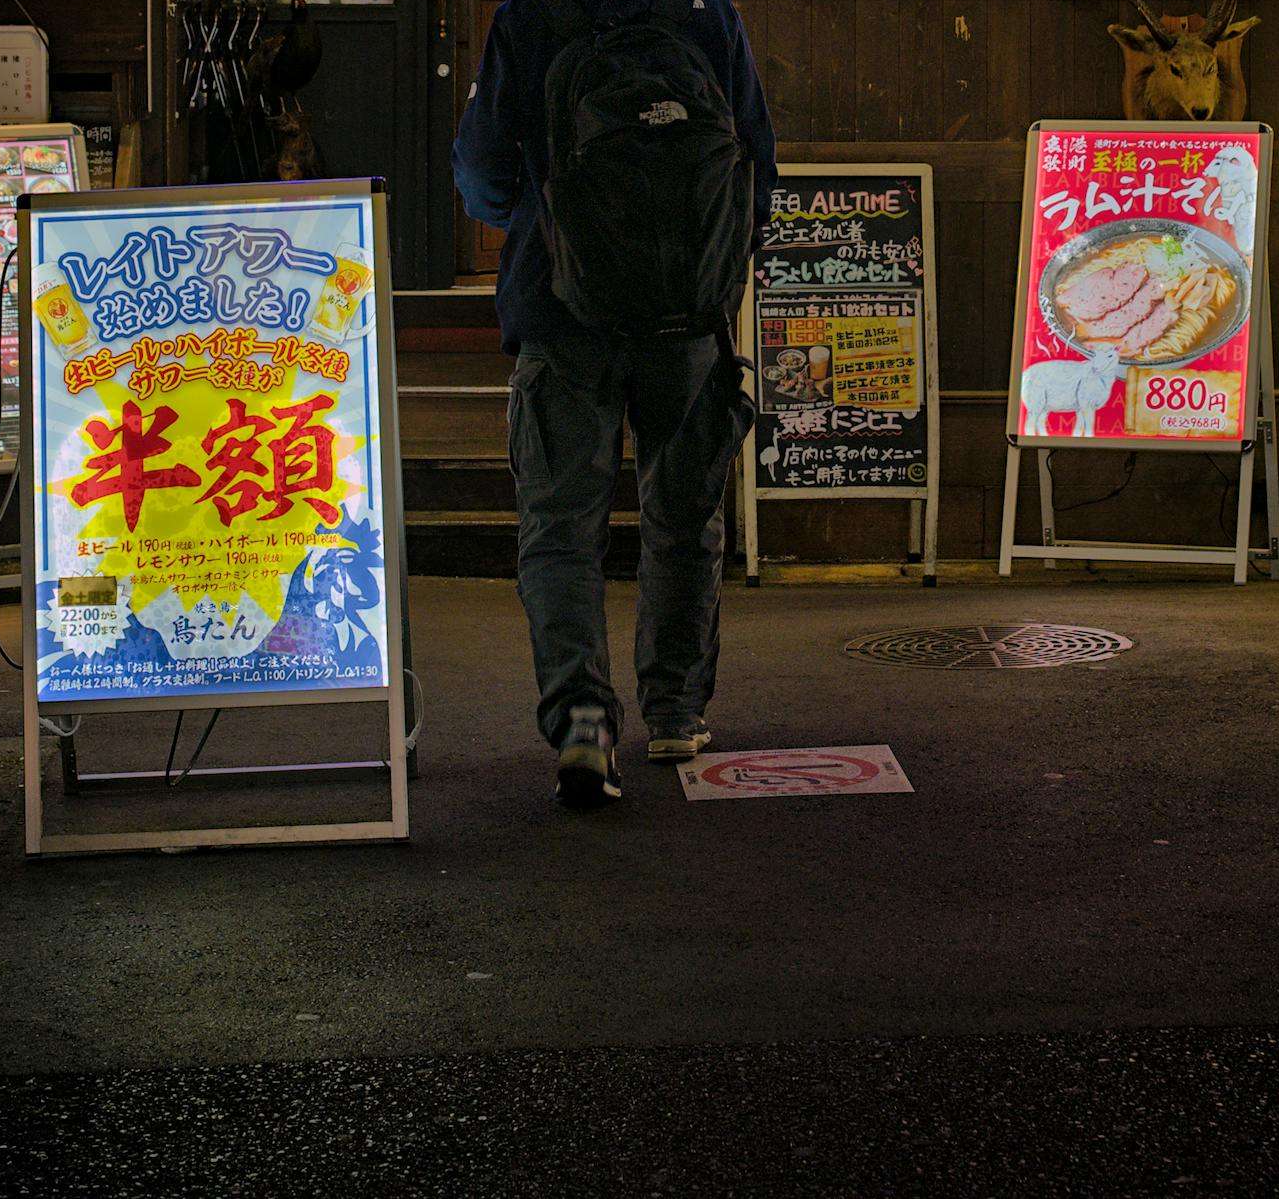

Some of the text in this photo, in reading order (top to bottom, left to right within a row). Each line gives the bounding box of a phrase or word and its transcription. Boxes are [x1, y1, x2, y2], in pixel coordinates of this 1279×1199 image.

[1091, 151, 1205, 173] 至極の一杯
[1039, 173, 1246, 231] ラム汁そば
[762, 220, 866, 247] ジビエ初心者
[60, 222, 339, 300] レイトアワー
[763, 256, 909, 288] ちょい飲みセット
[93, 274, 311, 343] 始めました!
[129, 361, 285, 400] サワー各種が
[1145, 376, 1226, 413] 880円
[71, 394, 343, 533] 半額
[783, 443, 923, 468] 店内にその他メニュー
[77, 540, 133, 557] 生ビール
[137, 554, 221, 569] レモンサワー
[61, 607, 118, 622] 22:00から
[170, 614, 256, 646] 鳥たん
